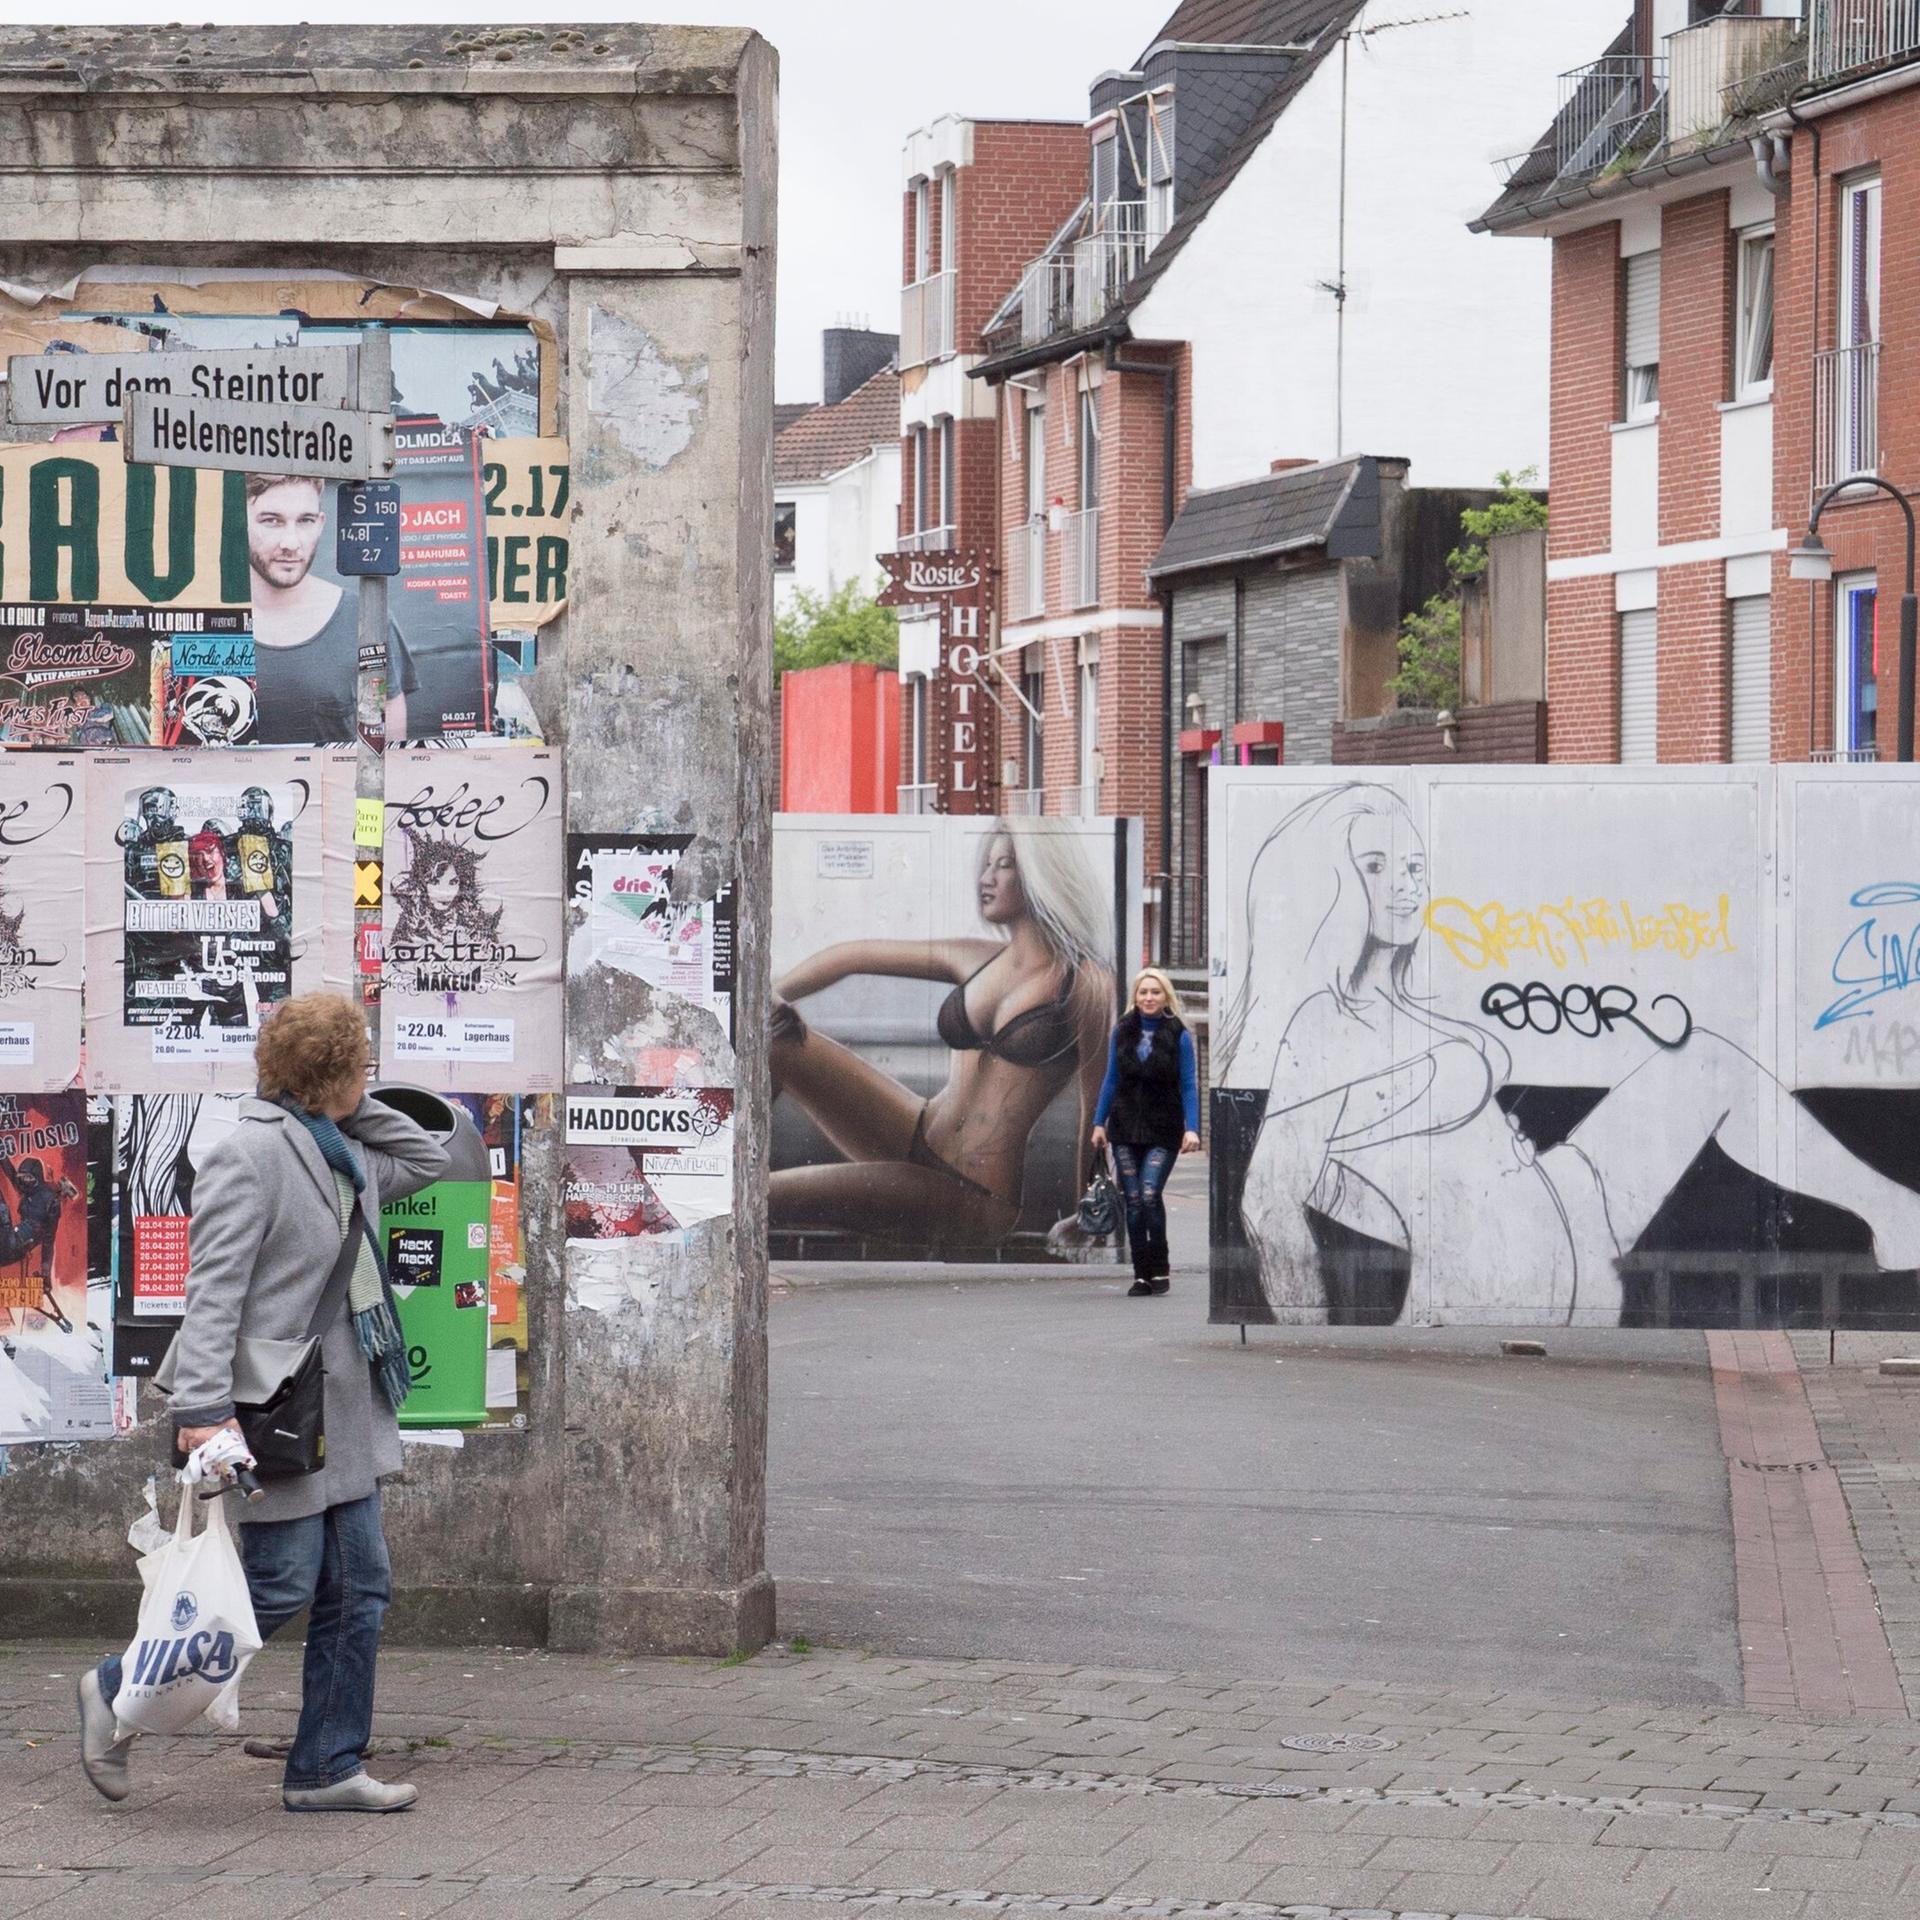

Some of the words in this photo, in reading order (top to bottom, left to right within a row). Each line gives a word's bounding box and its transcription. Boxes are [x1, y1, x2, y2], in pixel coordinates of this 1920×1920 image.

[35, 368, 86, 409] Vor
[191, 362, 325, 404] Steintor
[152, 406, 354, 464] Helenenstraße
[409, 456, 424, 464] DAS
[426, 455, 446, 463] LICHT
[449, 454, 464, 462] AUS
[353, 494, 367, 515] S
[374, 501, 398, 515] 150
[412, 509, 461, 527] JACH
[437, 532, 467, 540] PHYSICAL
[416, 549, 466, 559] MAHUMBA
[438, 578, 468, 587] SOBAKA
[440, 591, 468, 599] TOASTY
[7, 631, 135, 671] Gloomster
[175, 643, 221, 666] Nordic
[950, 605, 979, 793] HOTEL
[442, 712, 476, 721] 04.03.17
[128, 902, 189, 930] BITTER
[191, 902, 258, 930] VERSES
[230, 938, 276, 951] UNITED
[234, 956, 260, 967] AND
[416, 965, 482, 992] MAKEUP
[154, 1027, 164, 1035] Sa
[408, 1022, 447, 1037] 22.04.
[0, 1035, 30, 1045] erhaus
[222, 1032, 257, 1043] Lagerha
[464, 1032, 510, 1043] Lagerhaus
[155, 1046, 176, 1054] 20.00
[397, 1042, 417, 1050] 20.00
[568, 1107, 690, 1132] HADDOCKS
[33, 1121, 79, 1151] OSLO
[620, 1183, 645, 1194] UHR
[382, 1195, 437, 1216] anke!
[140, 1221, 185, 1229] 23.04.2017
[140, 1232, 185, 1240] 24.04.2017
[140, 1242, 185, 1250] 25.04.2017
[140, 1252, 185, 1260] 26.04.2017
[140, 1263, 185, 1271] 27.04.2017
[140, 1273, 185, 1281] 28.04.2017
[140, 1284, 185, 1292] 29.04.2017
[140, 1301, 170, 1309] Tickets:
[132, 1630, 237, 1686] VILSA
